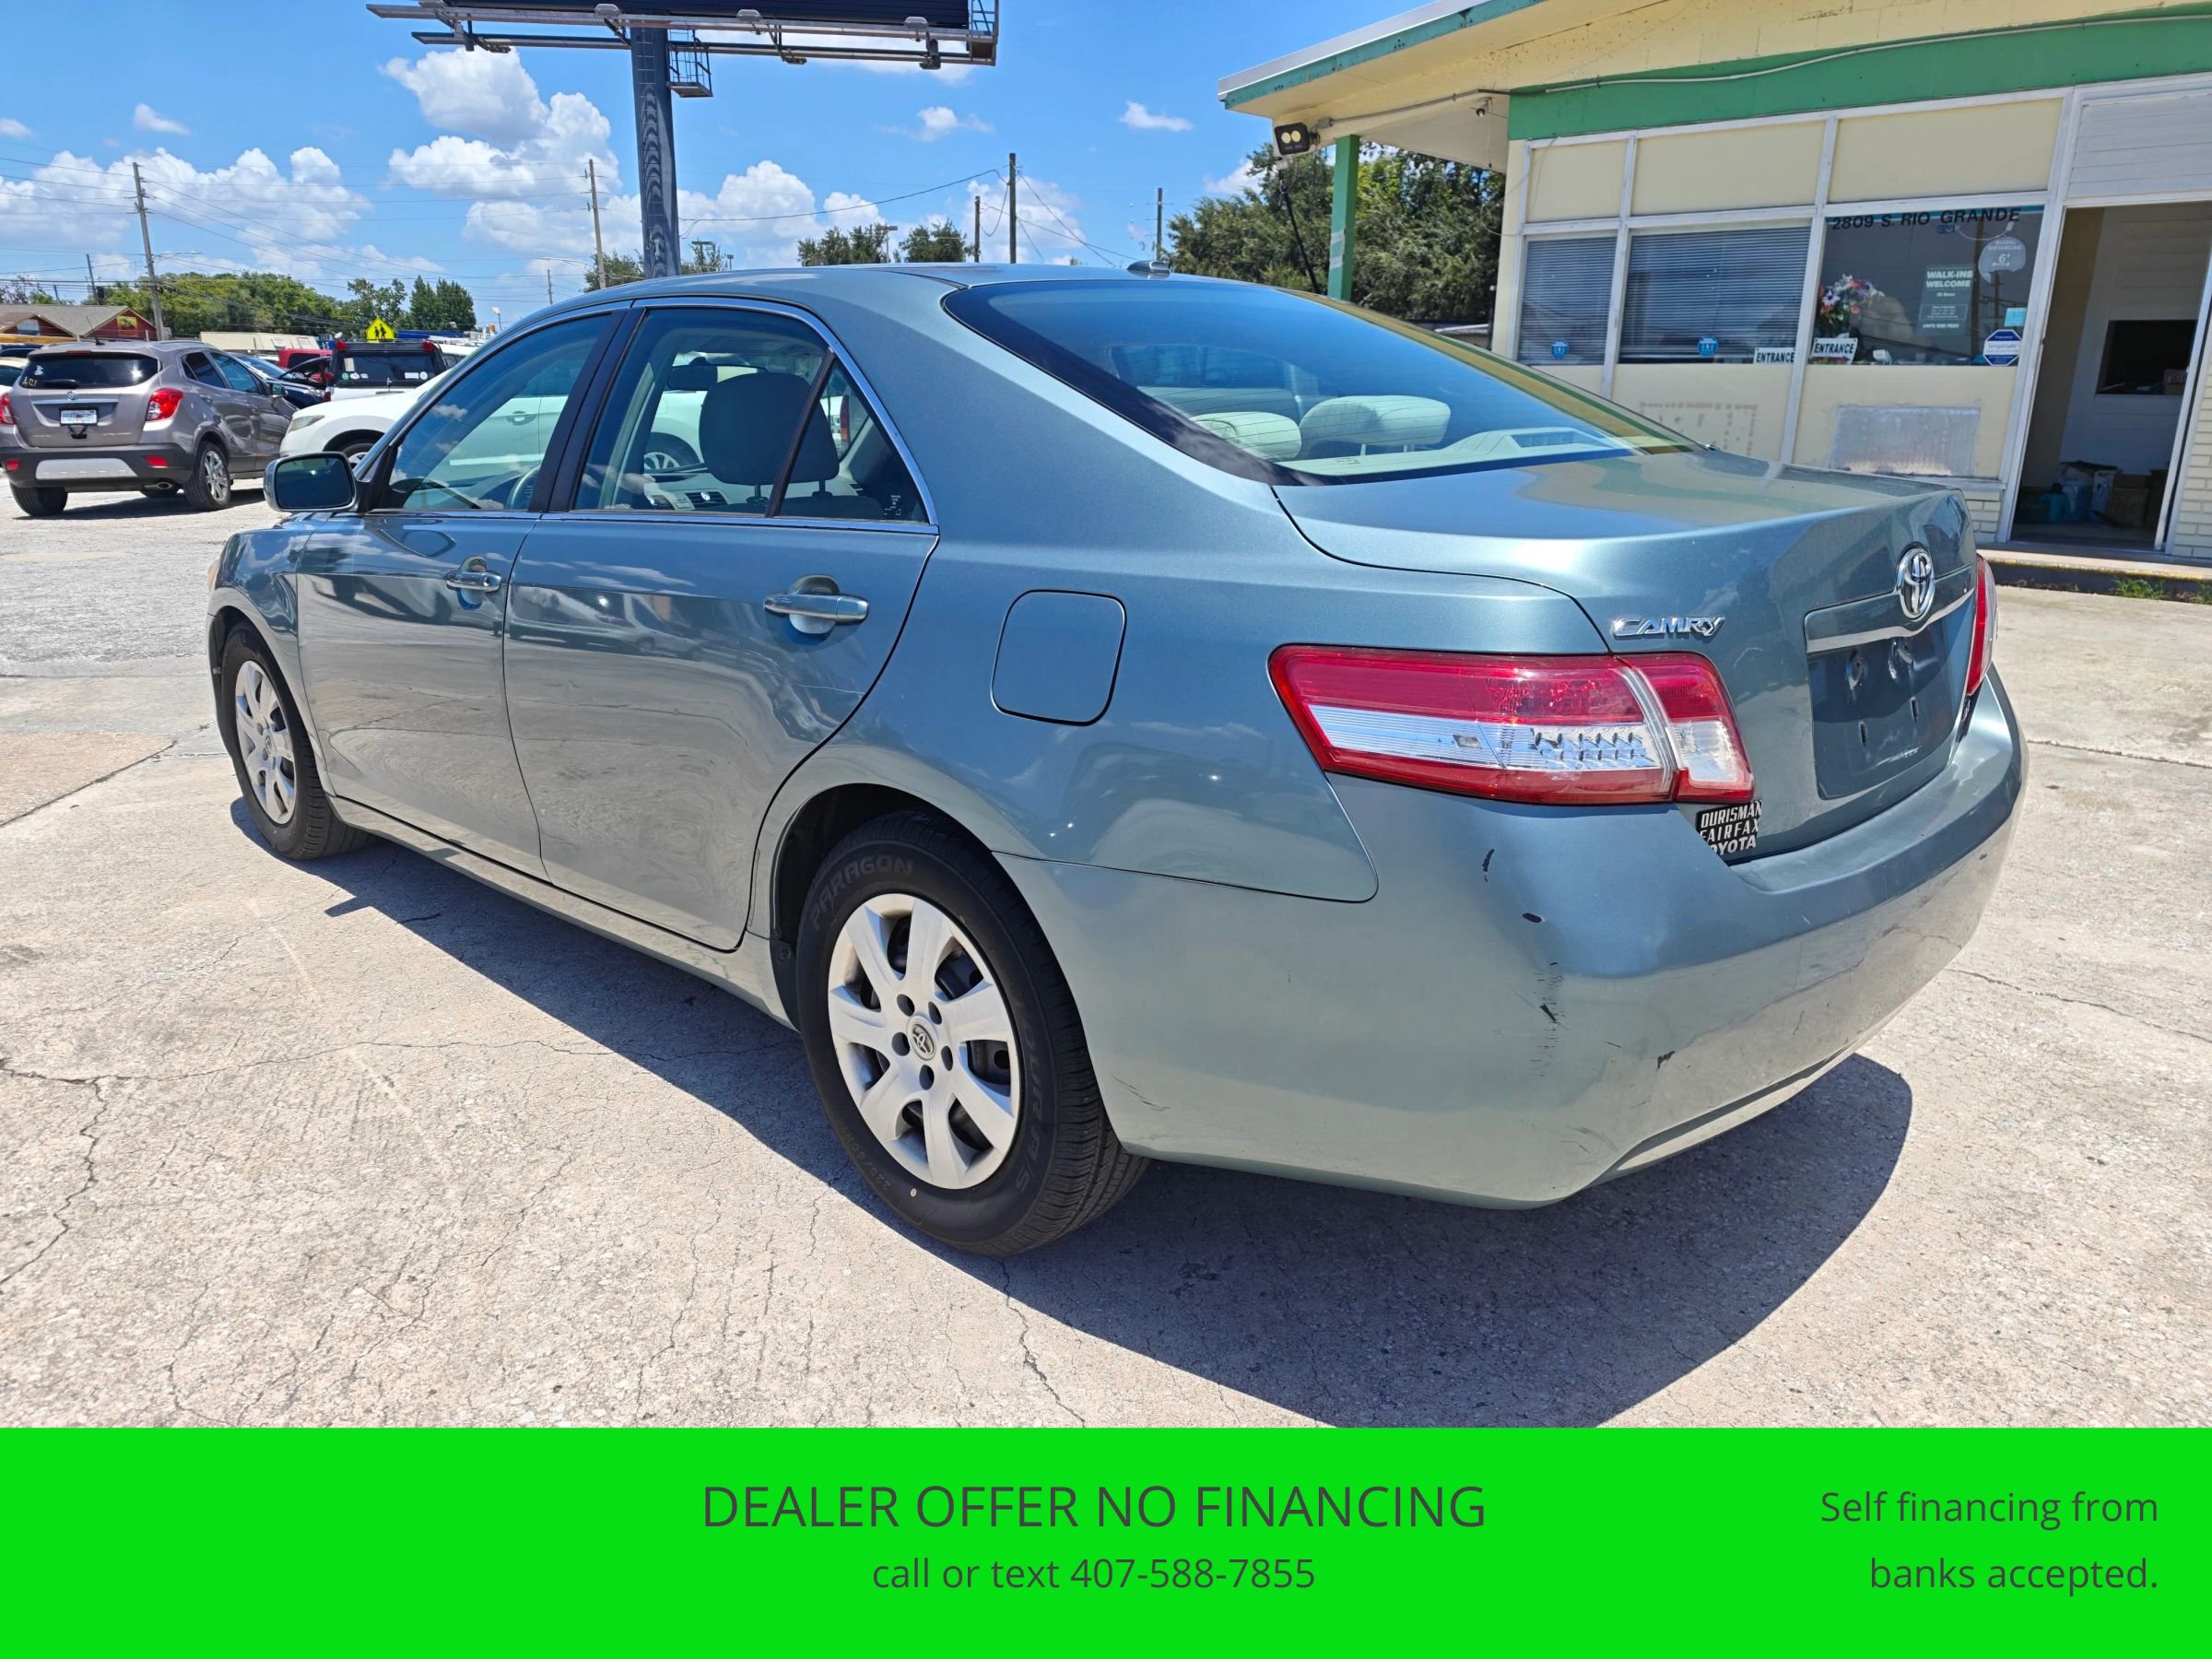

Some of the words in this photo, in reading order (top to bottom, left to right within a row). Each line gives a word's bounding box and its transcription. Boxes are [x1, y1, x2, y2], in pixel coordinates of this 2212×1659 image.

[1831, 215, 1874, 230] 2809
[1881, 213, 1895, 228] S.
[1900, 211, 1930, 226] RIO
[1940, 207, 2021, 224] GRANDE
[1926, 270, 1973, 279] WALK-INS
[1926, 279, 1971, 288] WELCOME
[1756, 352, 1795, 363] ENTRANCE
[1814, 342, 1854, 354] ENTRANCE
[1612, 615, 1726, 639] CAMRY
[1700, 799, 1763, 829] OURISMAN
[1700, 817, 1760, 843] FAIRFAX
[1710, 834, 1757, 856] OYOTA
[810, 854, 915, 932] PARAGON
